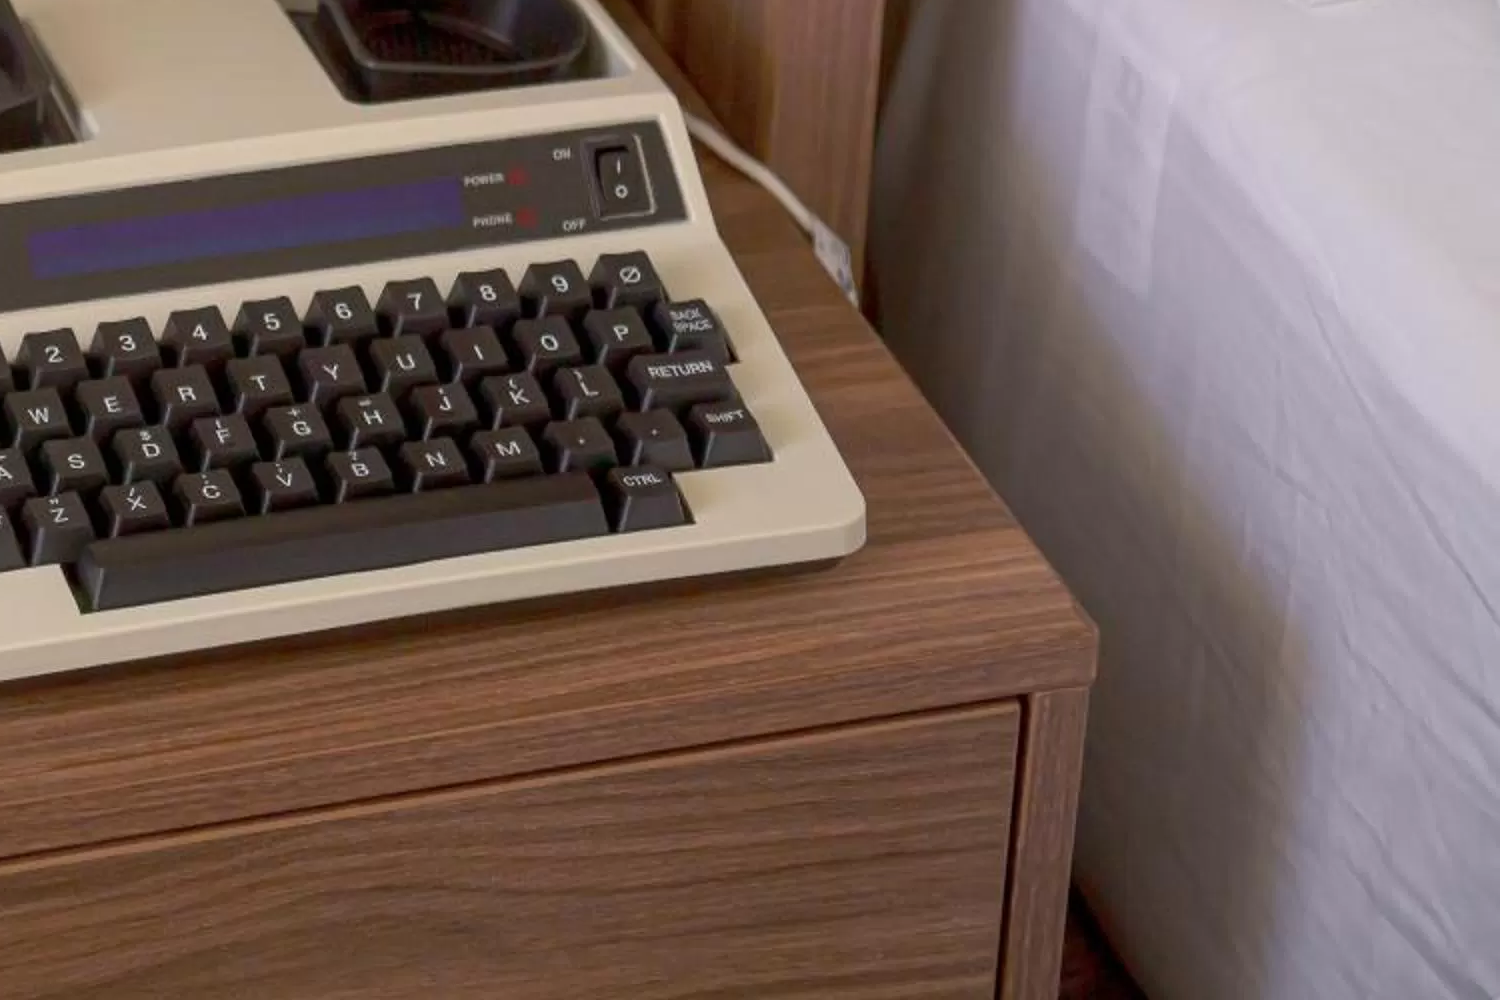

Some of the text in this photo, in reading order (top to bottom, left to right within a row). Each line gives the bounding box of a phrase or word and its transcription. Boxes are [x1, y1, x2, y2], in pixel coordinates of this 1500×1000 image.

[553, 148, 572, 161] ON
[464, 172, 505, 188] POWER
[473, 212, 513, 228] PHONE
[562, 218, 587, 232] OFF
[551, 274, 569, 293] 9
[480, 284, 497, 302] 8
[407, 292, 423, 311] 7
[335, 303, 352, 320] 6
[263, 313, 281, 331] 5
[673, 319, 713, 333] SPACE
[192, 324, 209, 341] 4
[613, 324, 629, 342] P
[119, 334, 136, 352] 3
[540, 334, 559, 352] O
[45, 346, 64, 364] 2
[473, 344, 485, 361] I
[396, 353, 416, 370] U
[648, 360, 713, 379] RETURN
[323, 364, 339, 381] Y
[250, 375, 266, 391] T
[580, 380, 599, 396] L
[178, 386, 197, 402] R
[509, 389, 530, 405] K
[104, 396, 121, 413] E
[439, 396, 452, 411] J
[28, 407, 50, 425] W
[363, 410, 383, 425] H
[705, 409, 745, 424] SHIFT
[215, 429, 231, 444] F
[292, 421, 312, 436] G
[141, 443, 161, 458] D
[496, 441, 521, 457] M
[67, 454, 85, 470] S
[425, 451, 446, 467] N
[352, 463, 370, 478] B
[276, 472, 293, 487] V
[623, 472, 663, 488] CTRL
[203, 484, 221, 499] C
[127, 495, 148, 511] X
[51, 508, 69, 523] Z
